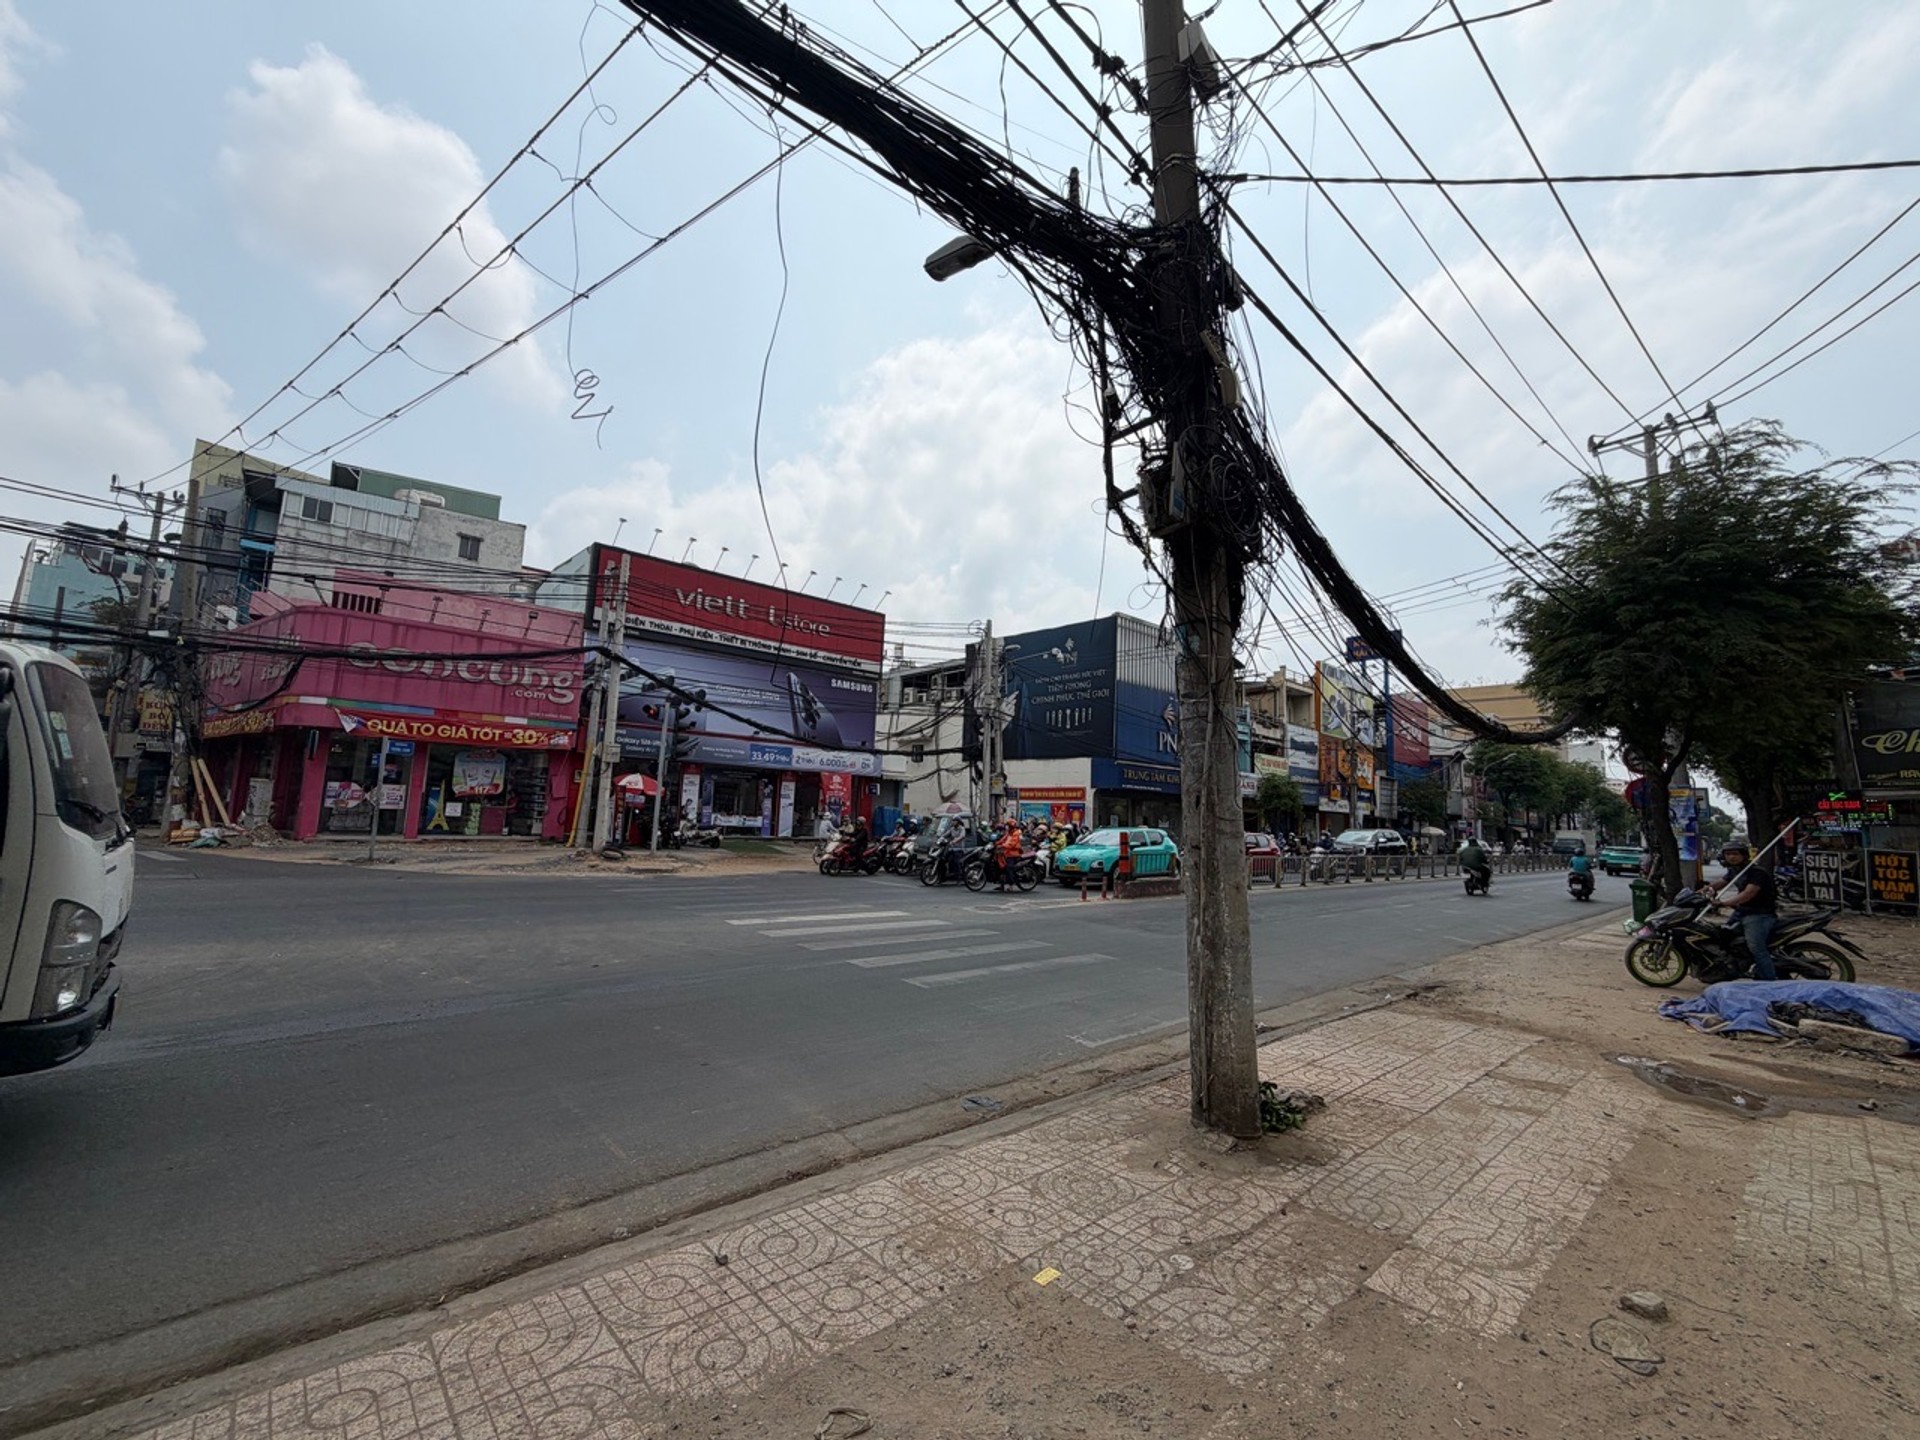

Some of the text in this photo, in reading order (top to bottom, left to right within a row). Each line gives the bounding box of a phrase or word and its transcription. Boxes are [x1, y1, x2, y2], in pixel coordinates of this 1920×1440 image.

[782, 614, 831, 638] store
[831, 678, 873, 693] SAMSUNG
[409, 722, 435, 736] TO
[437, 722, 468, 739] GIÁ
[1158, 730, 1178, 753] PN
[1808, 869, 1837, 885] RÁY
[1812, 886, 1835, 900] TAI
[1871, 879, 1916, 894] NAM
